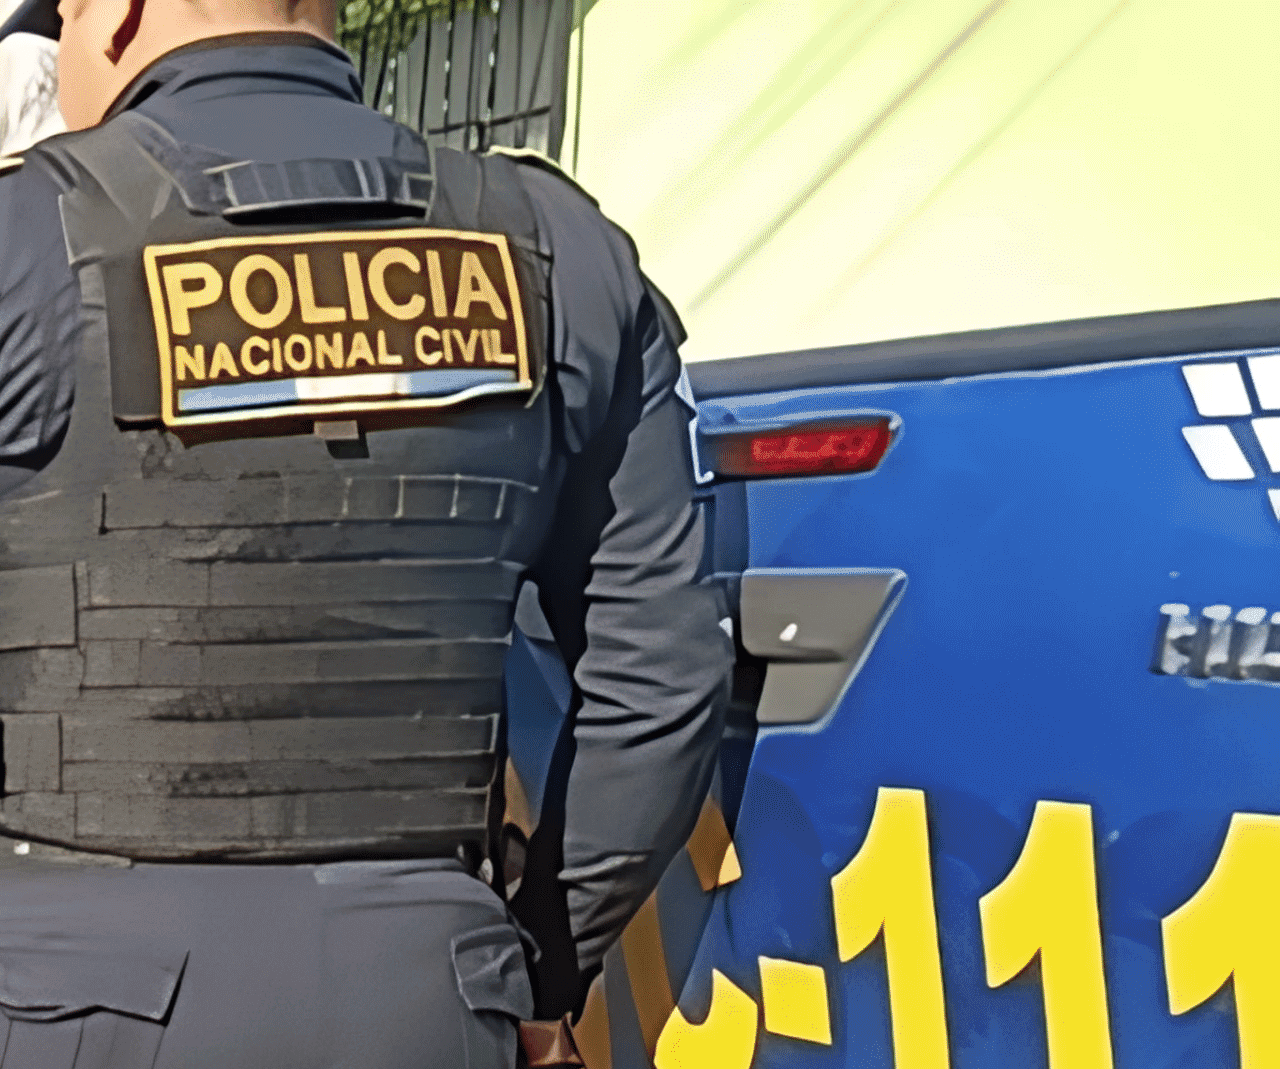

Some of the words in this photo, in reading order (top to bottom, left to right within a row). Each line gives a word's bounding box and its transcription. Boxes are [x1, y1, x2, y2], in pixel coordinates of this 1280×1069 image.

[162, 246, 508, 337] POLICIA
[174, 331, 403, 382] NACIONAL
[414, 325, 516, 366] CIVIL
